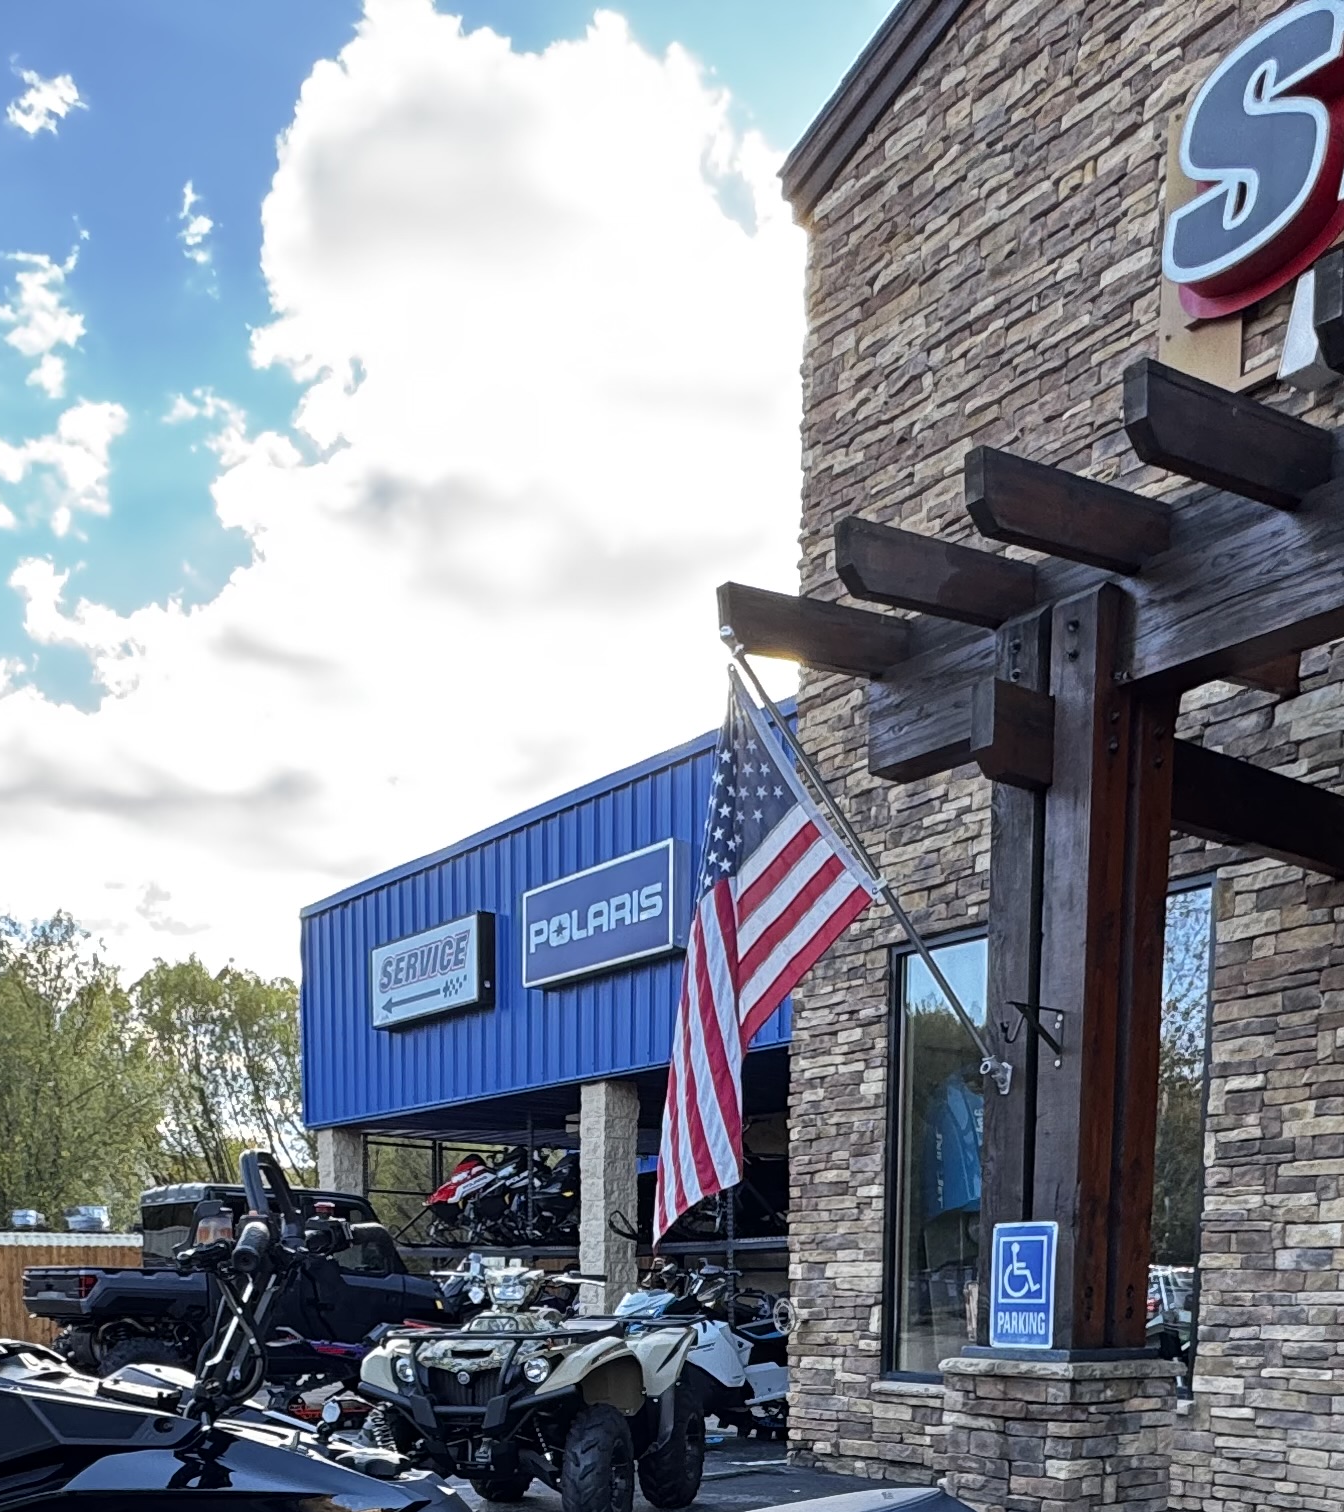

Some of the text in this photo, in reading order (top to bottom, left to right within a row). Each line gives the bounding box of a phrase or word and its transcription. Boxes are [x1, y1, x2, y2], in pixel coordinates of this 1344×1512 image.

[529, 882, 663, 954] POLARIS
[379, 930, 471, 993] SERVICE
[997, 1311, 1046, 1335] PARKING
